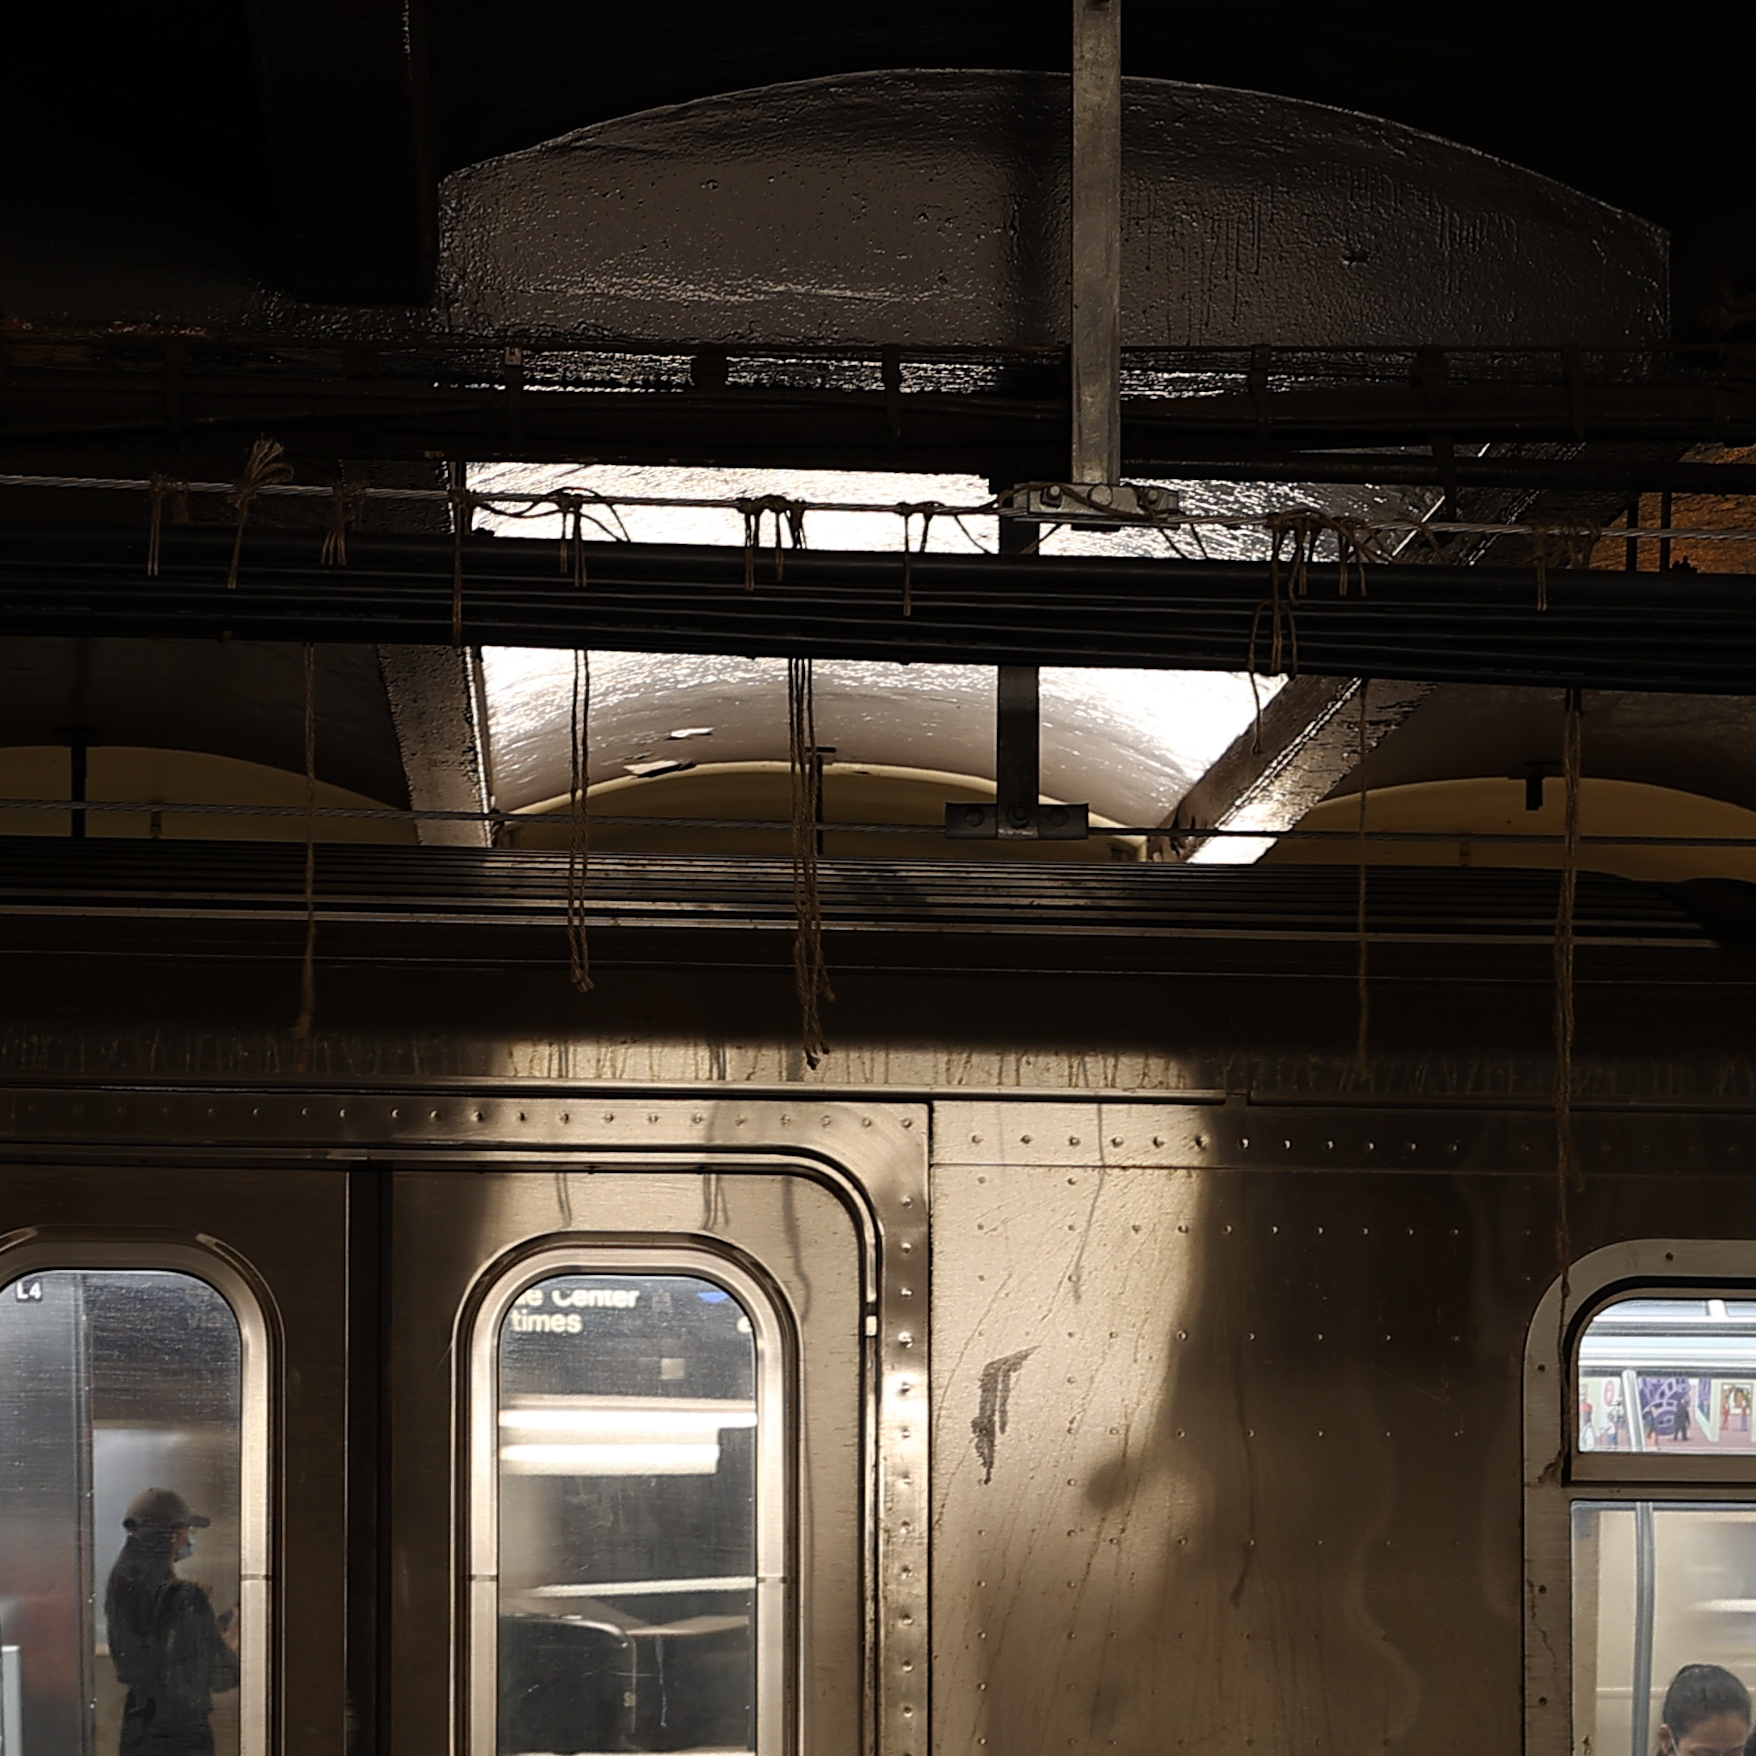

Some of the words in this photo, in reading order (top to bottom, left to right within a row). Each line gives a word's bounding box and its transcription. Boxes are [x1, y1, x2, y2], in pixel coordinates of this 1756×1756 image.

[16, 1281, 42, 1299] L4
[552, 1289, 640, 1308] Center
[511, 1308, 583, 1333] times
